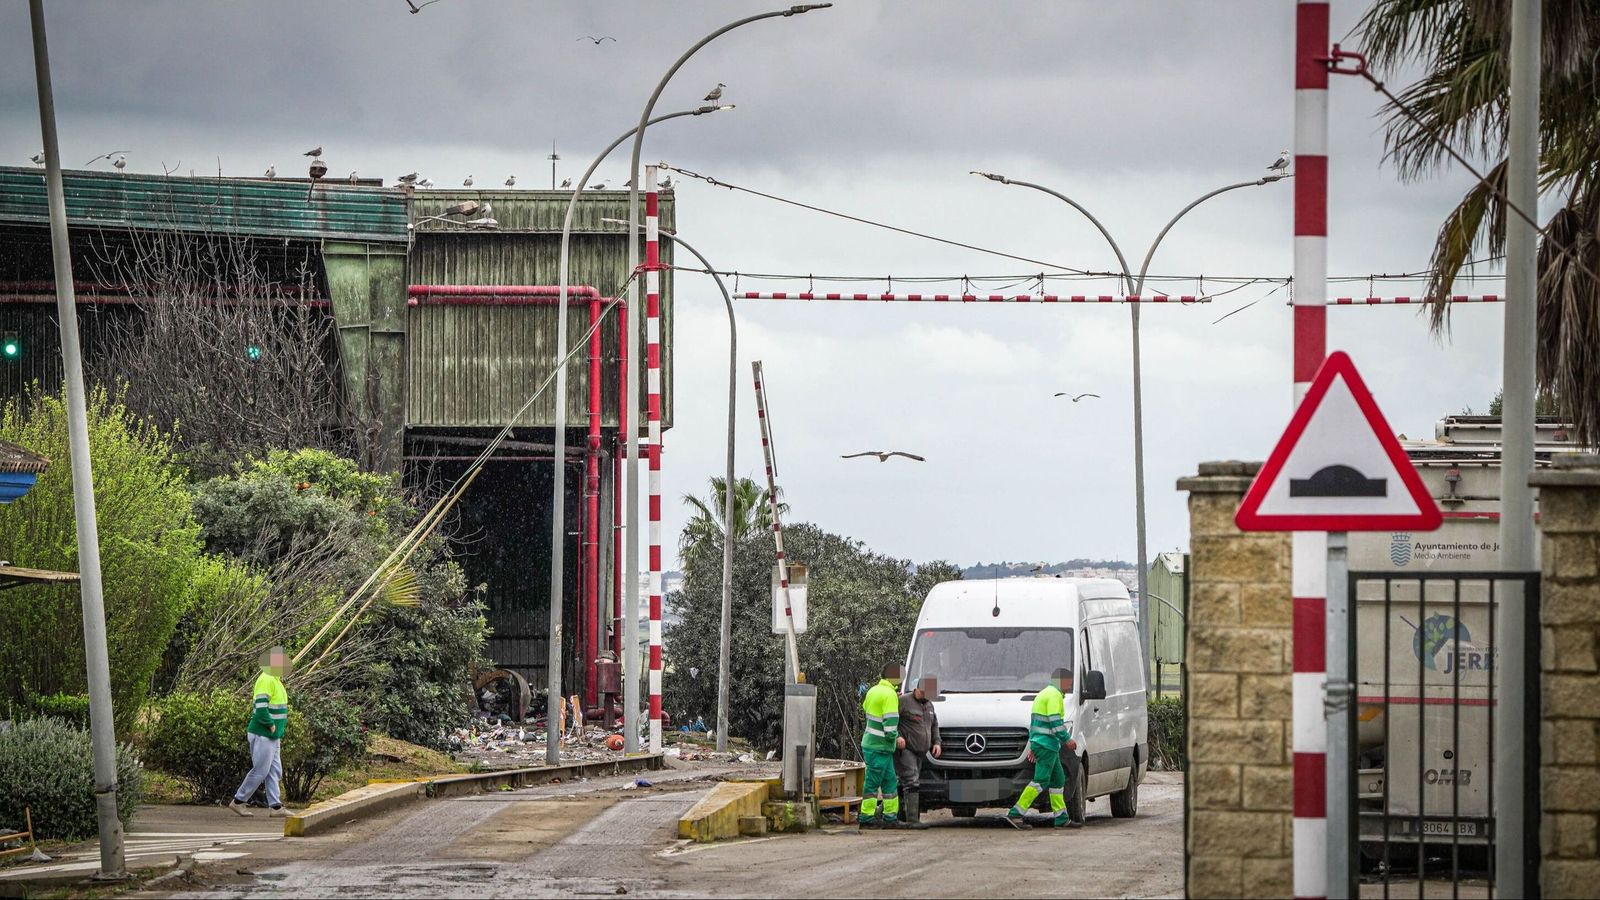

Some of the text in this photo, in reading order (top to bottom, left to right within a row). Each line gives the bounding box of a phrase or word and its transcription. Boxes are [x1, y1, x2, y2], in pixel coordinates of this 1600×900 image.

[1414, 542, 1478, 551] Ayuntamiento
[1480, 542, 1491, 550] de
[1414, 552, 1471, 560] Medio Ambiente
[1423, 822, 1449, 833] 3064
